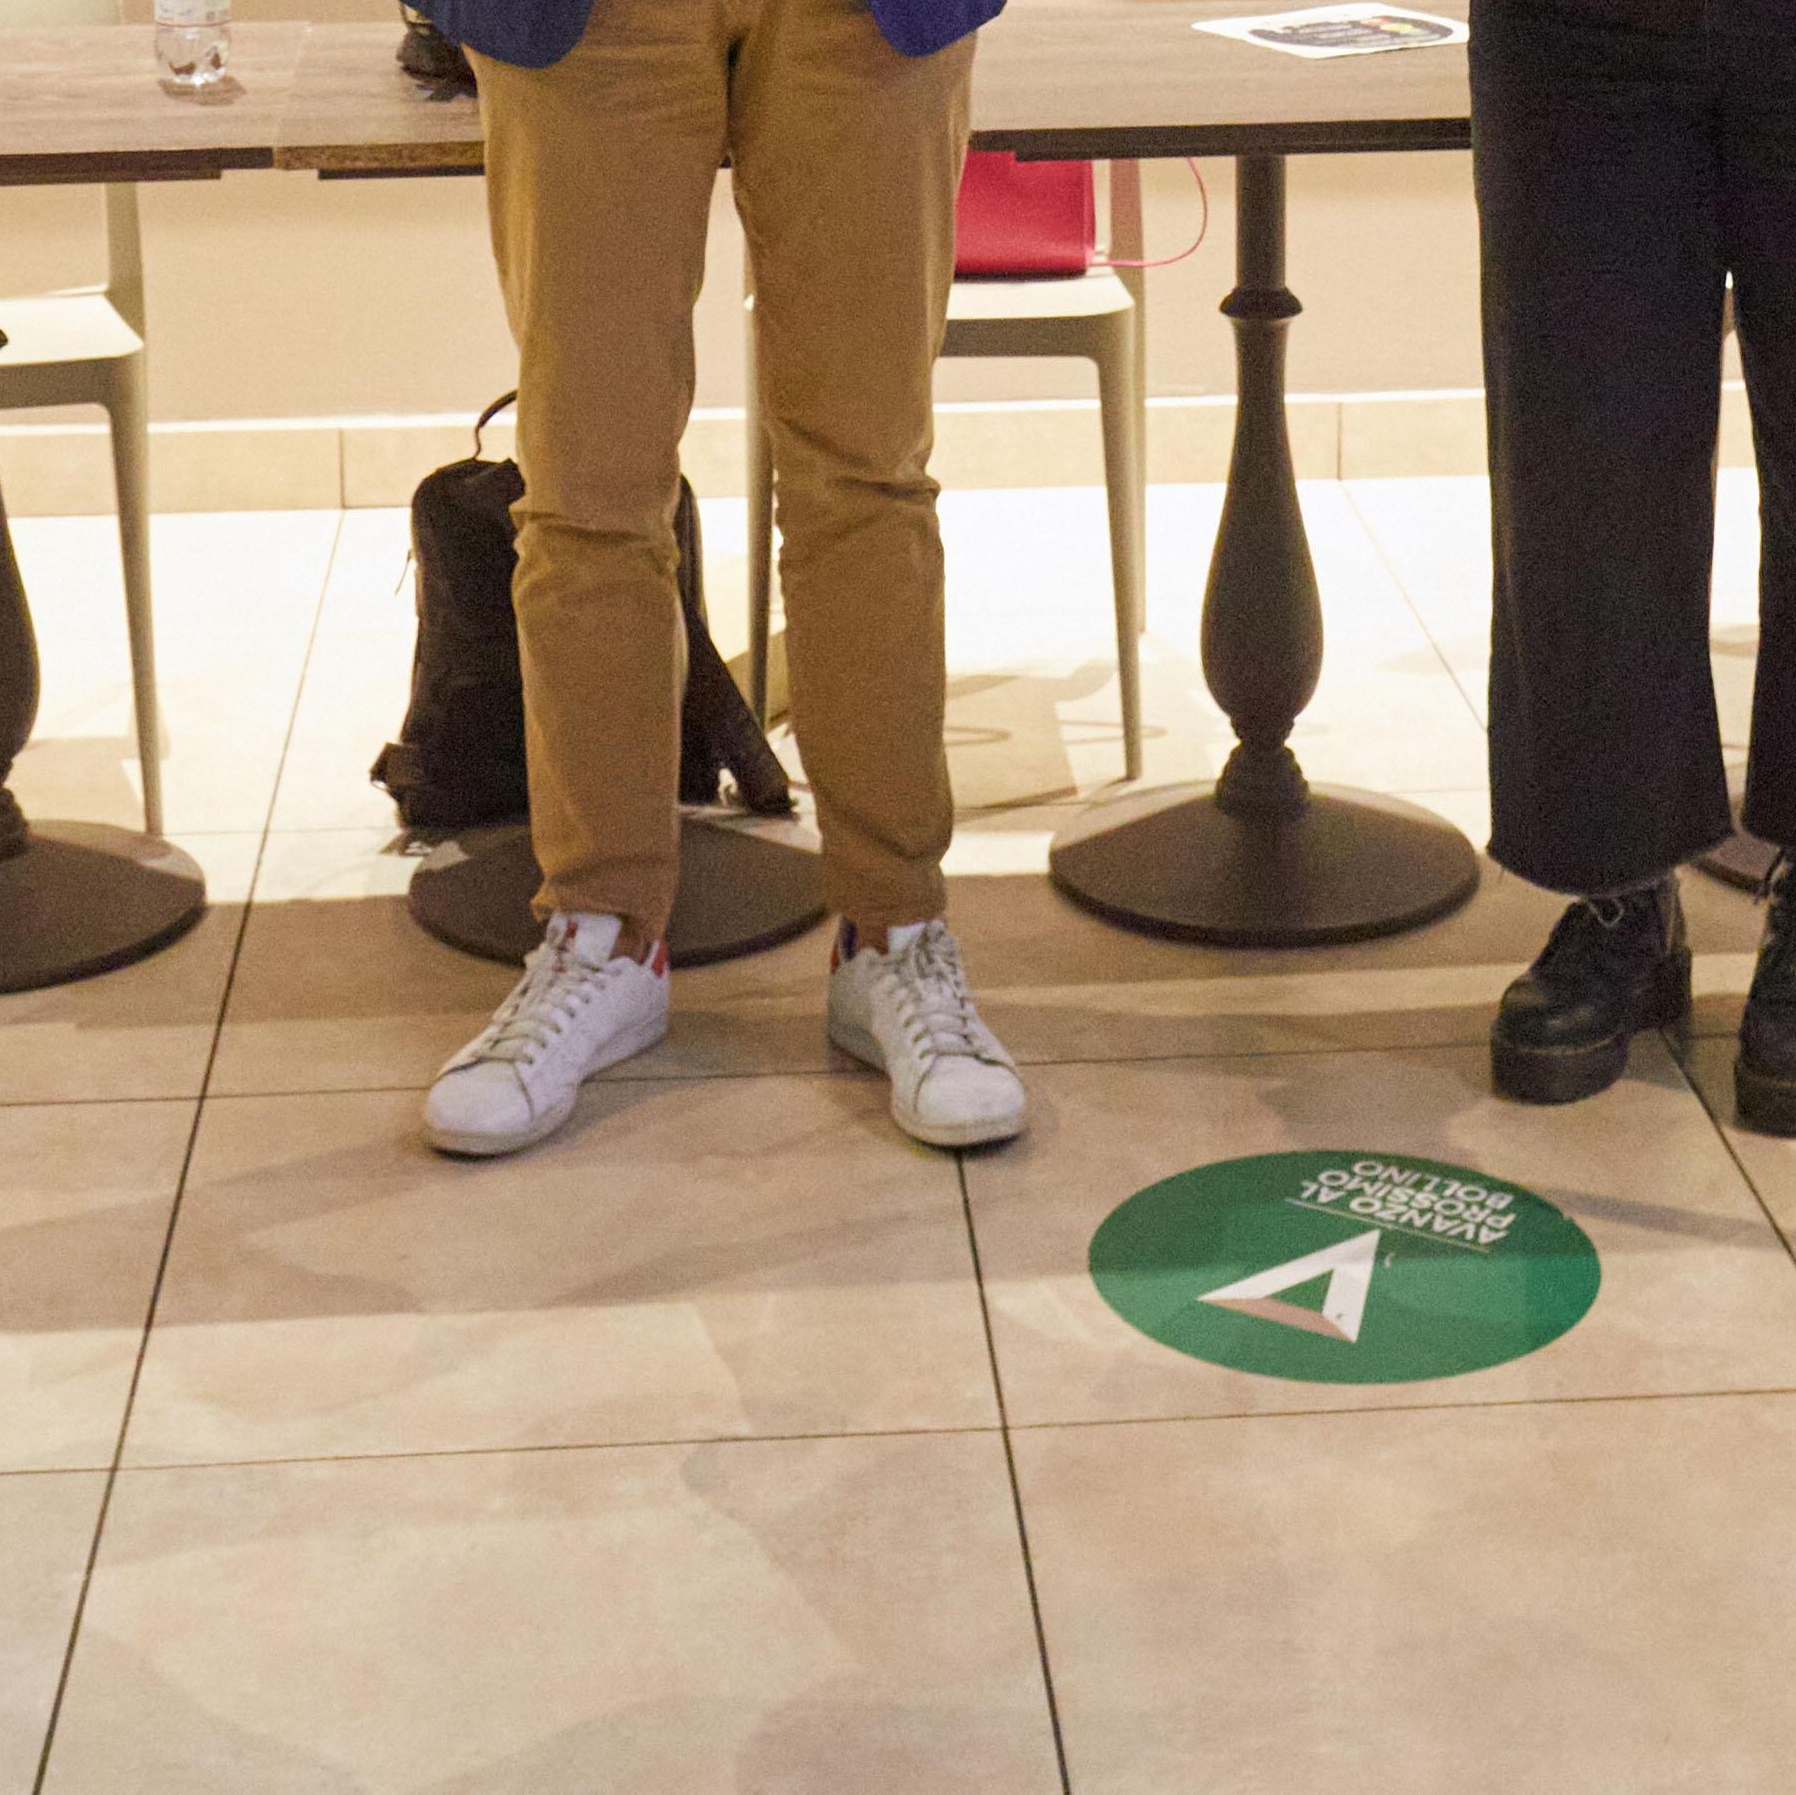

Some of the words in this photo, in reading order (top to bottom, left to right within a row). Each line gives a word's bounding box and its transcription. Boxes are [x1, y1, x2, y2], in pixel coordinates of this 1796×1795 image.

[1300, 1179, 1347, 1203] AL
[1318, 1170, 1517, 1229] PROSSIMO
[1352, 1160, 1515, 1210] BOLLINO
[1349, 1196, 1509, 1244] AVANZO
